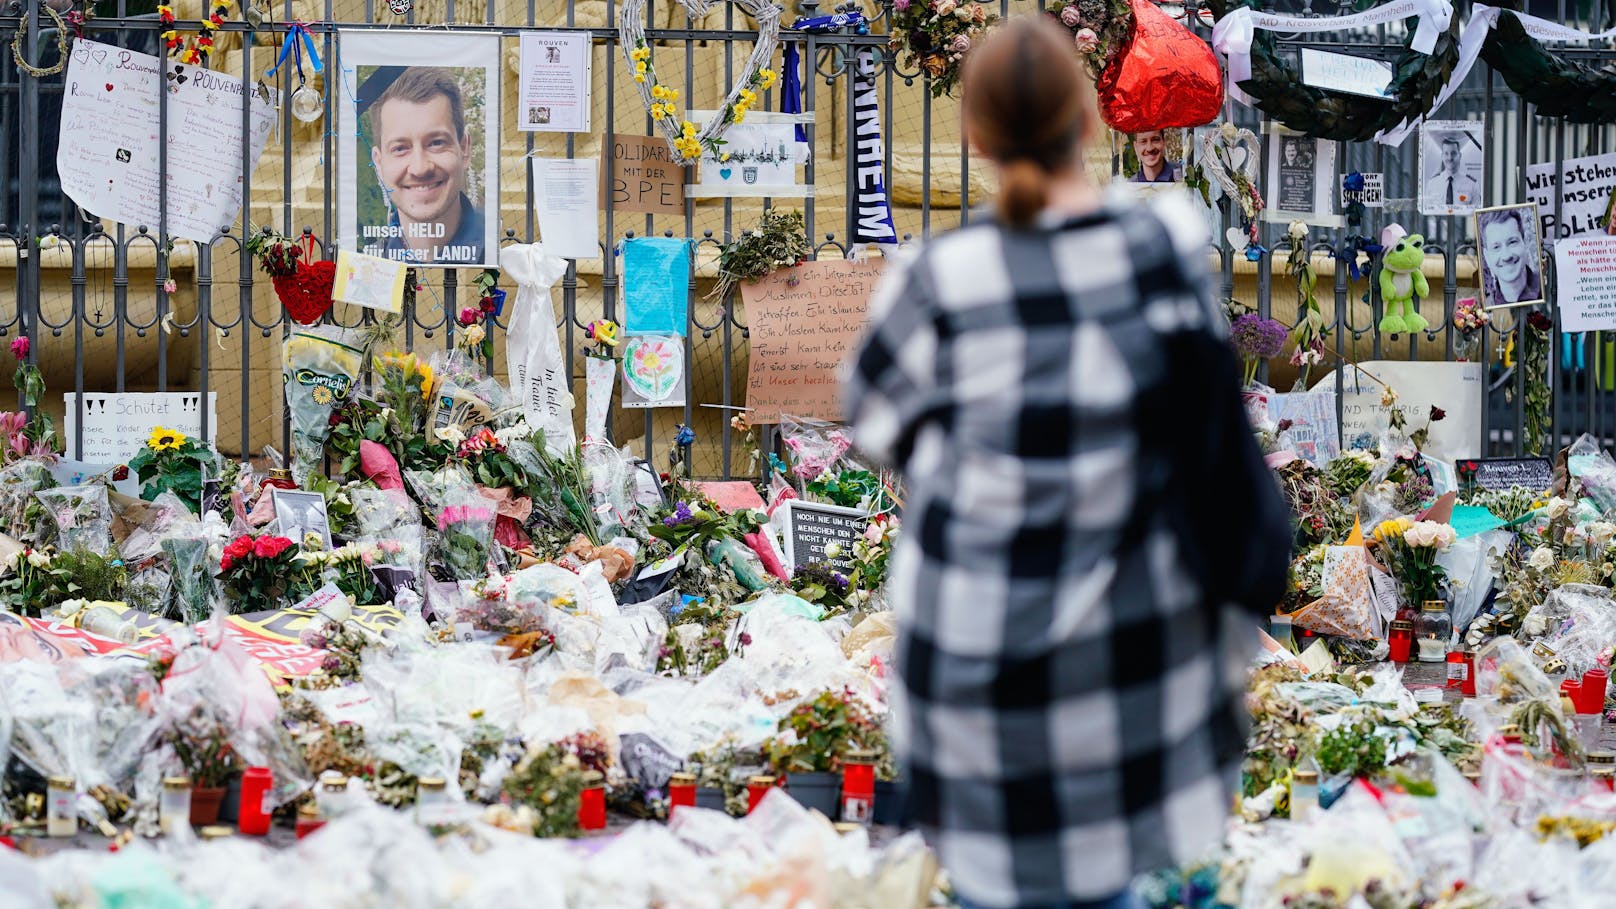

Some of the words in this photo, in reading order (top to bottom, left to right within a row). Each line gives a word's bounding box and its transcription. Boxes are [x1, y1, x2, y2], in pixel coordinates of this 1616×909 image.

[1363, 2, 1415, 23] Mannheim
[624, 167, 642, 177] MIT
[646, 168, 666, 179] DER
[1526, 173, 1556, 191] Wir
[363, 225, 402, 238] unser
[408, 222, 445, 238] HELD
[363, 244, 385, 259] für
[388, 248, 429, 261] unser
[433, 245, 477, 261] LAND!
[1568, 248, 1607, 257] Menschen
[1590, 256, 1611, 264] hätte
[1581, 285, 1605, 293] Leben
[296, 370, 349, 392] Cornelis
[545, 368, 555, 382] In
[531, 375, 543, 413] Trauer
[546, 386, 562, 417] tiefer
[115, 397, 169, 416] Schützt
[83, 426, 104, 434] nsere
[1342, 421, 1367, 430] NKEN
[1483, 463, 1519, 473] Rouven
[796, 512, 815, 522] NOCH
[818, 515, 830, 524] NIE
[832, 517, 843, 526] UM
[797, 524, 835, 537] MENSCHEN
[837, 529, 851, 539] DEN
[798, 533, 820, 543] NICHT
[822, 537, 851, 548] KANNTE
